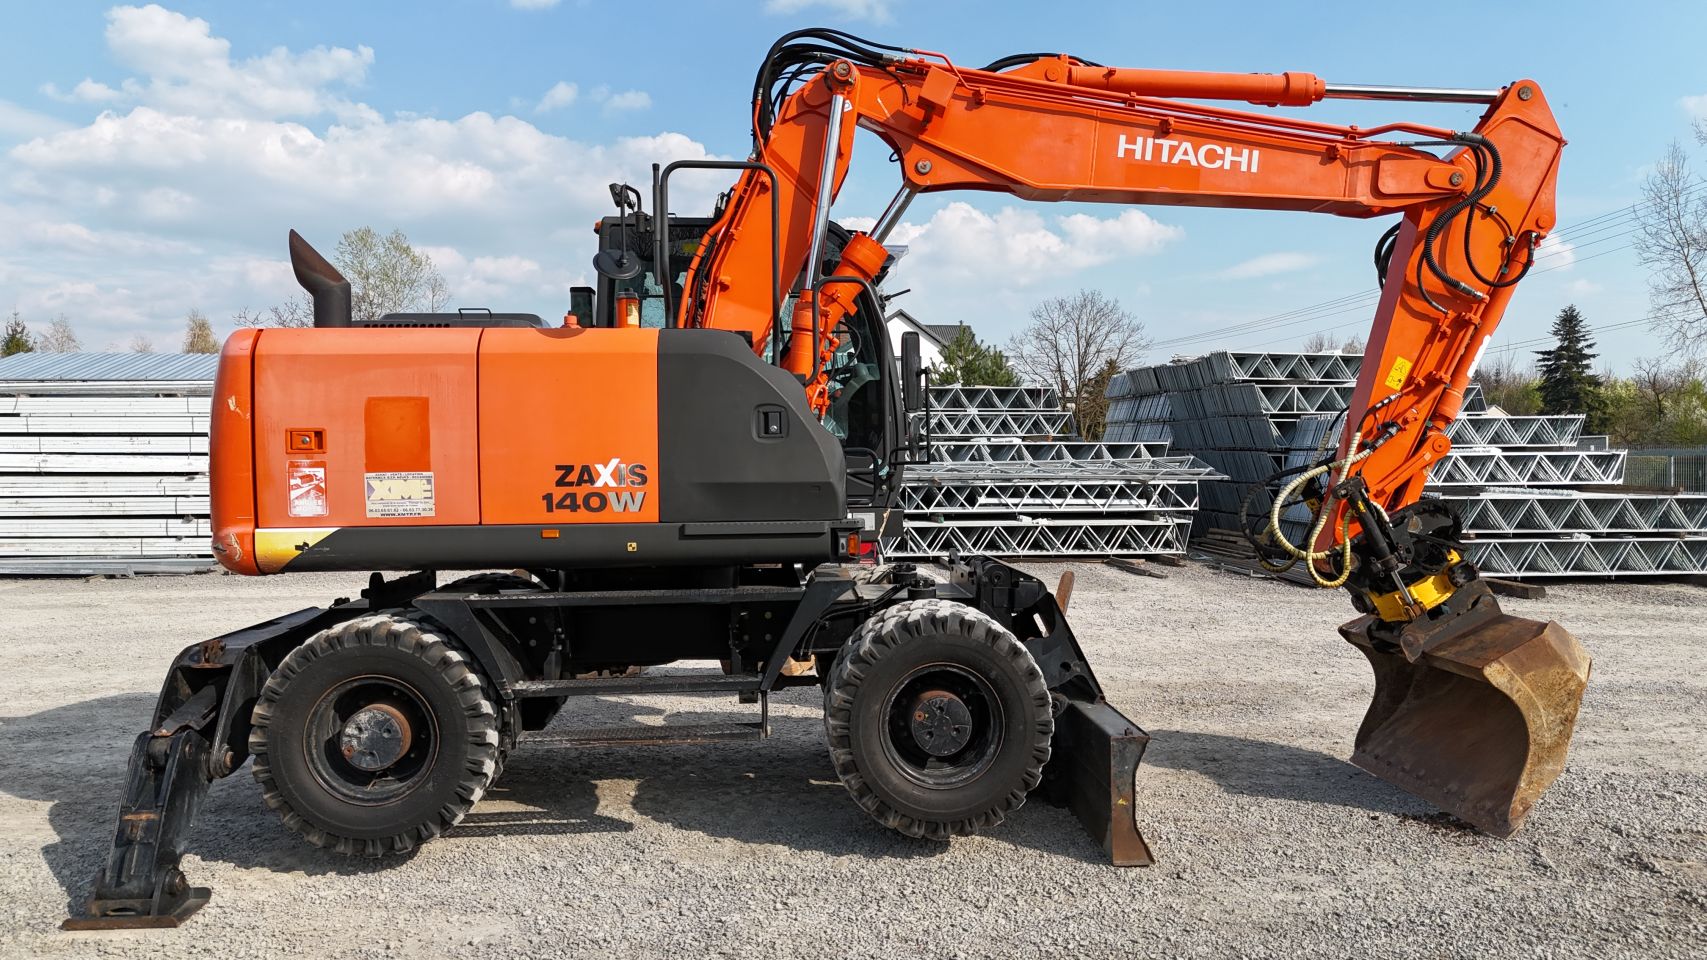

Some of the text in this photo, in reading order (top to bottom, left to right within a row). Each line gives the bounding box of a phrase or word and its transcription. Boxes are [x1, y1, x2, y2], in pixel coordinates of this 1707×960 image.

[1117, 134, 1260, 173] HITACHI
[555, 457, 648, 487] ZAXIS
[542, 492, 646, 513] 140W
